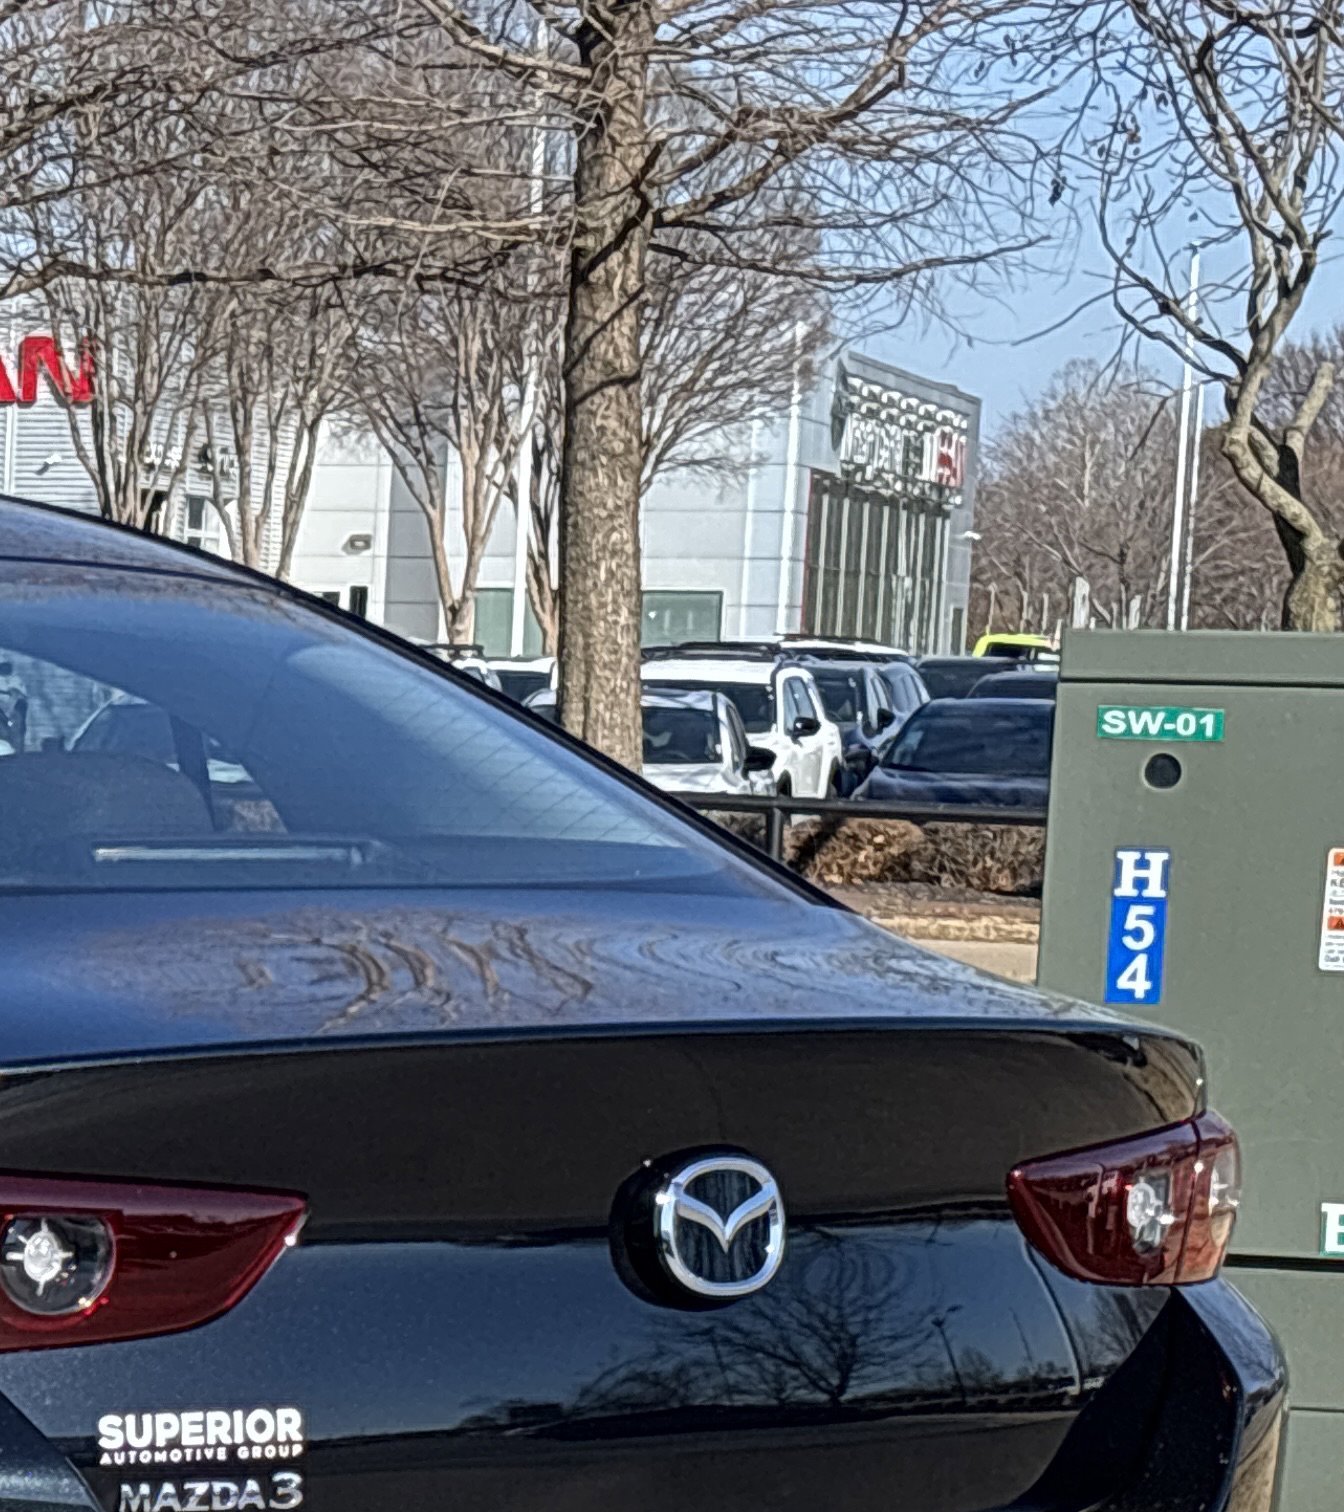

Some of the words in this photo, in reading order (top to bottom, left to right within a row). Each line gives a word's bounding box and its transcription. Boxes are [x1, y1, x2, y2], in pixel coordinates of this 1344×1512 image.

[1101, 709, 1216, 738] SW-01
[98, 1408, 304, 1449] SUPERIOR
[99, 1447, 227, 1465] AUTOMOTIVE
[237, 1444, 304, 1460] GROUP
